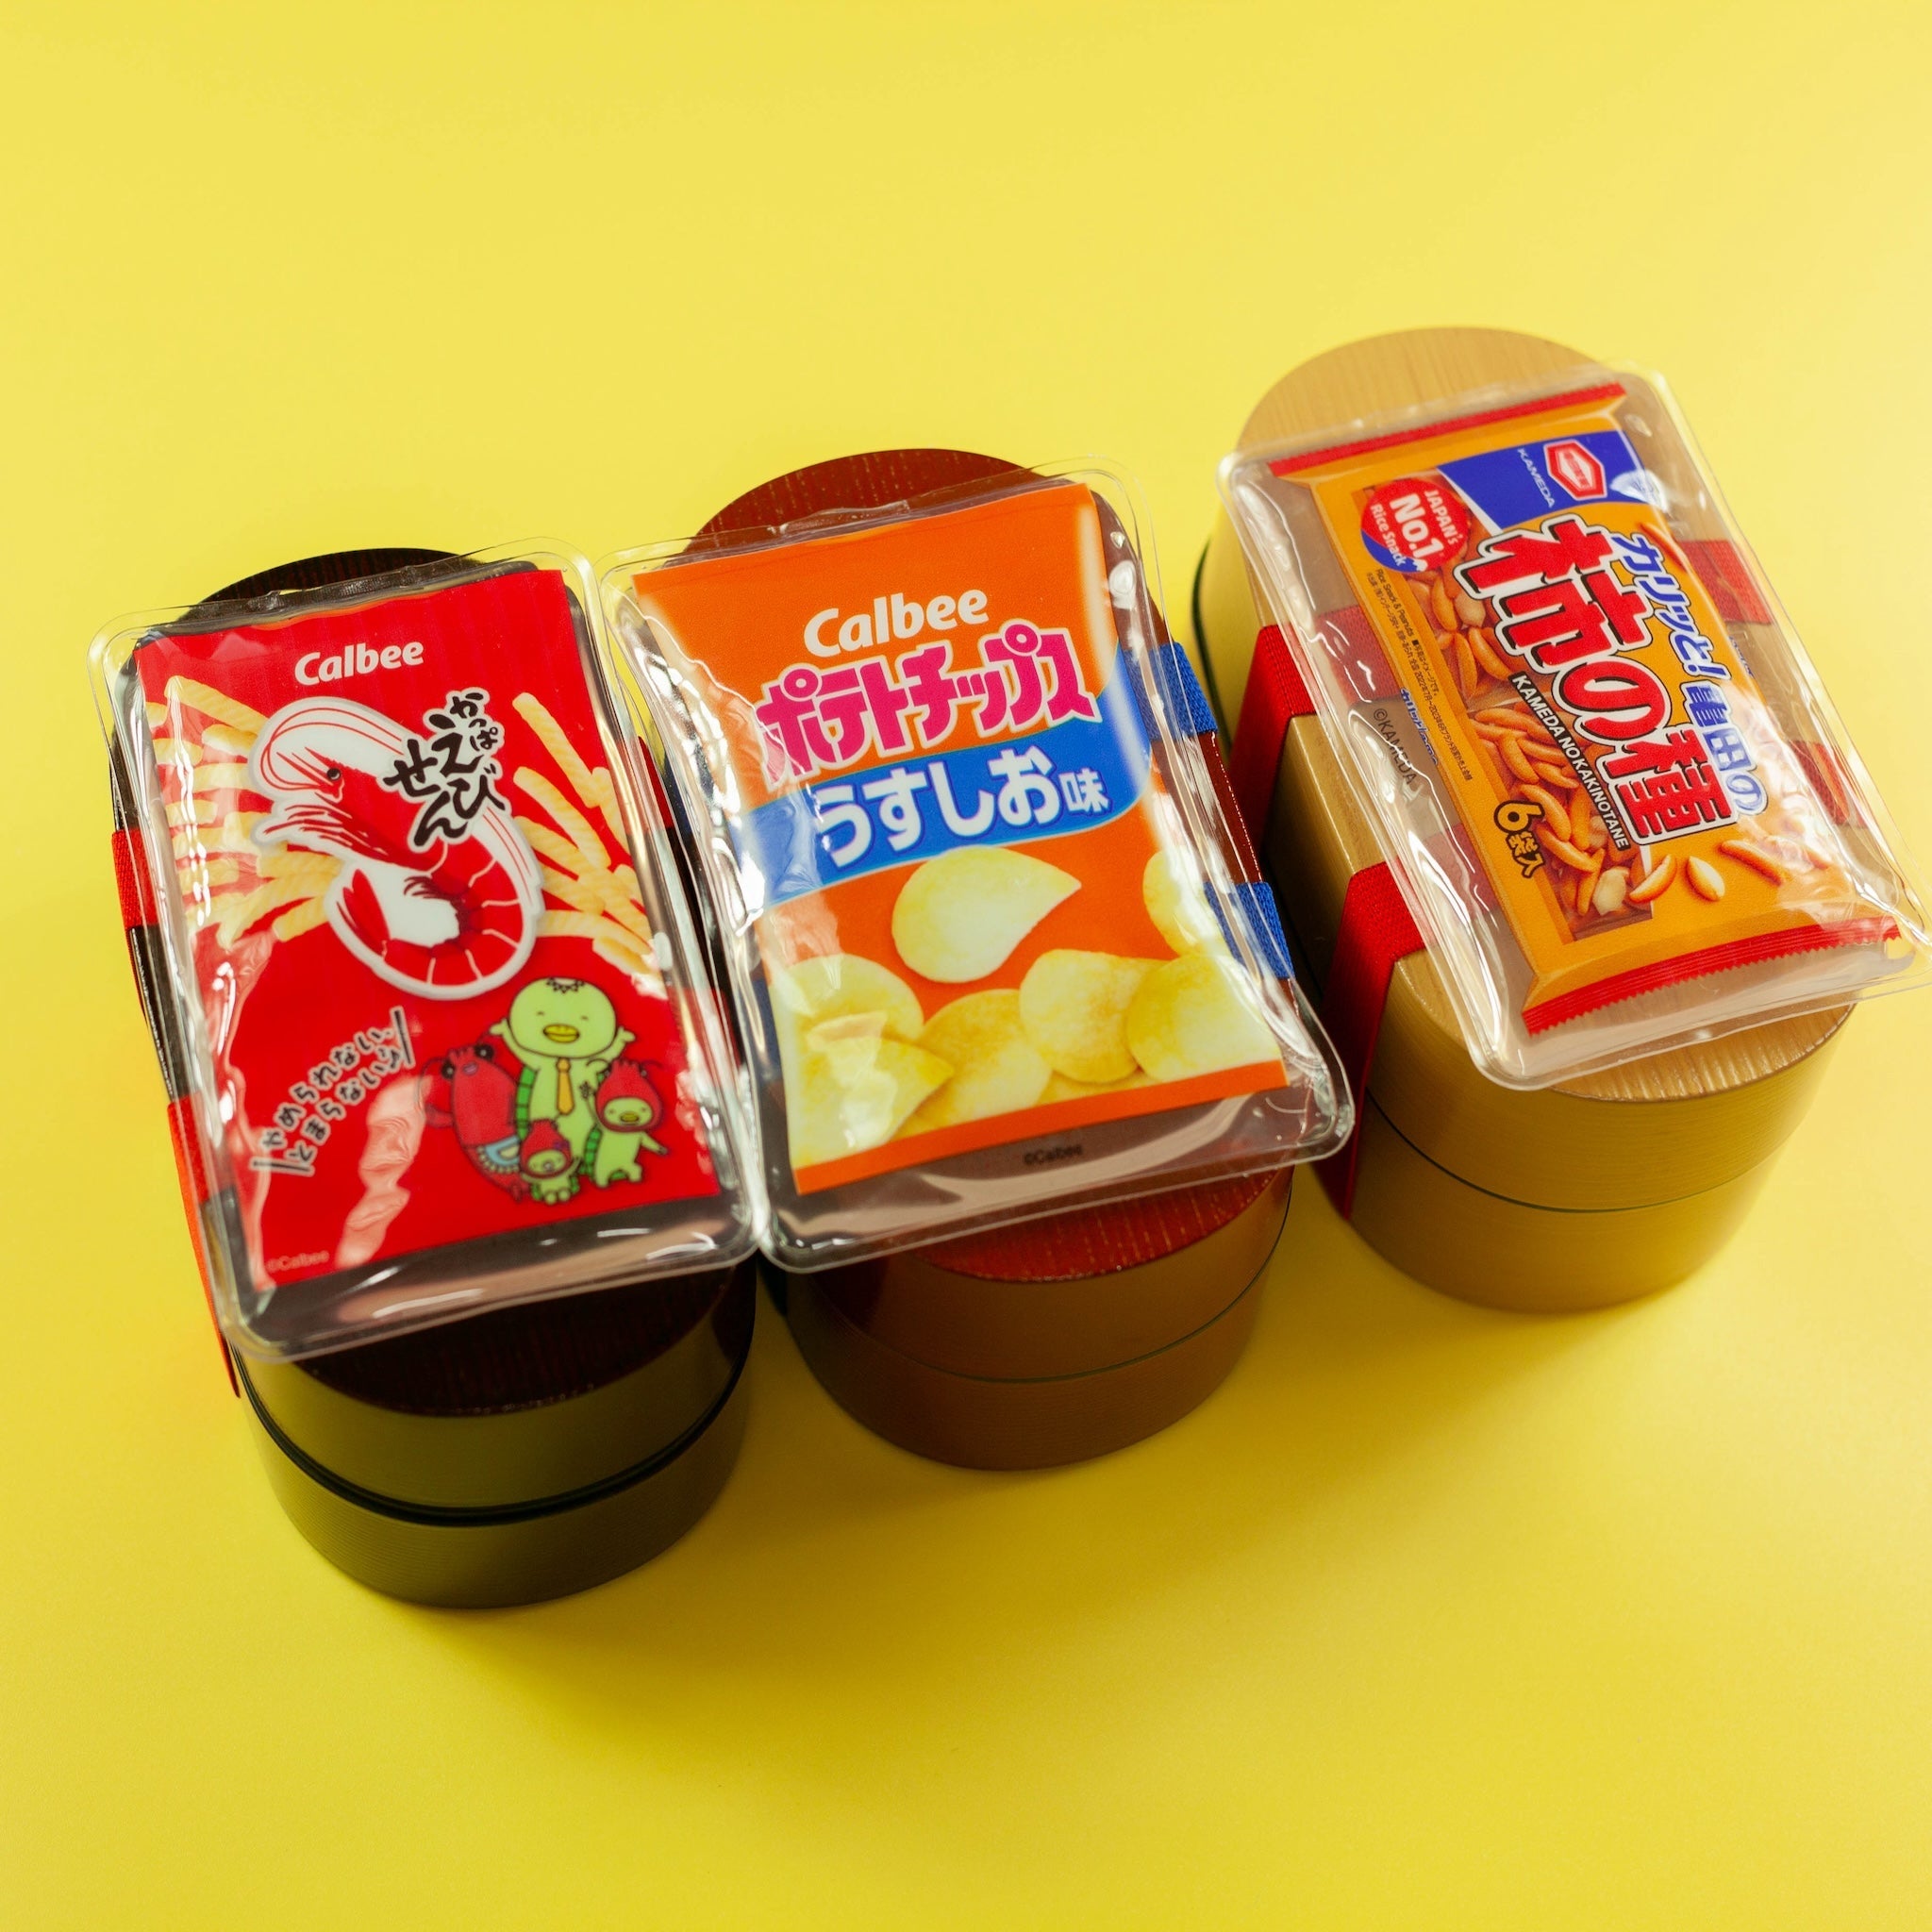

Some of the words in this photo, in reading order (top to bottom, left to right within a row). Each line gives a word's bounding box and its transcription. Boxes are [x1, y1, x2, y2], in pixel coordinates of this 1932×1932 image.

[1517, 448, 1556, 508] KAMEDA
[1370, 504, 1390, 532] Rice
[1382, 530, 1407, 567] Snack
[1390, 492, 1444, 558] No.1
[1424, 490, 1463, 545] JAPAN's
[803, 589, 989, 658] Calbee
[293, 640, 425, 686] Calbee
[1459, 516, 1735, 841] 柿の種
[755, 622, 1102, 788] ポテトチップス
[1511, 675, 1565, 738] KAMEDA
[1558, 735, 1581, 758] NO
[1573, 758, 1629, 850] KAKINOTANE
[817, 746, 1109, 868] うすしお味
